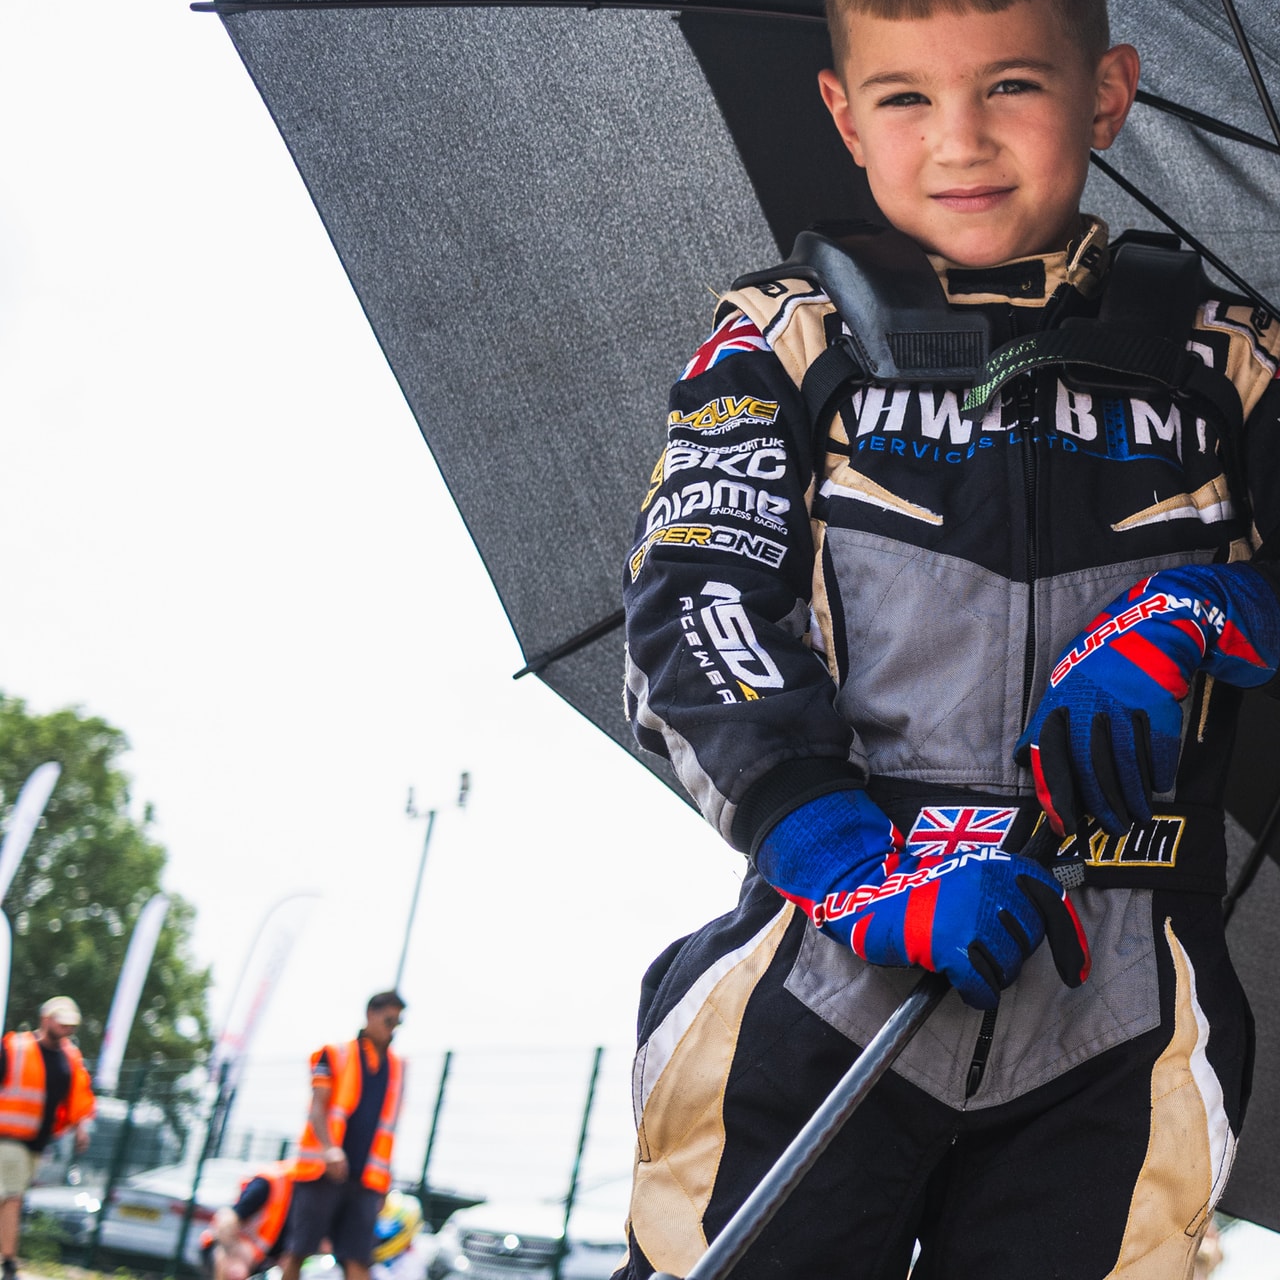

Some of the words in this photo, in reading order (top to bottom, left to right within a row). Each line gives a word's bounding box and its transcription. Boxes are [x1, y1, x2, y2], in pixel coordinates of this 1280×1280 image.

[668, 395, 780, 431] VOLVE
[667, 438, 760, 454] MOTORSPORT
[762, 437, 785, 448] UK
[664, 447, 787, 481] BKC
[710, 506, 752, 521] ENDLESS
[754, 516, 788, 535] RACING
[629, 523, 788, 584] SPERONE
[679, 596, 738, 705] RCEWEA
[1057, 815, 1186, 867] XTON
